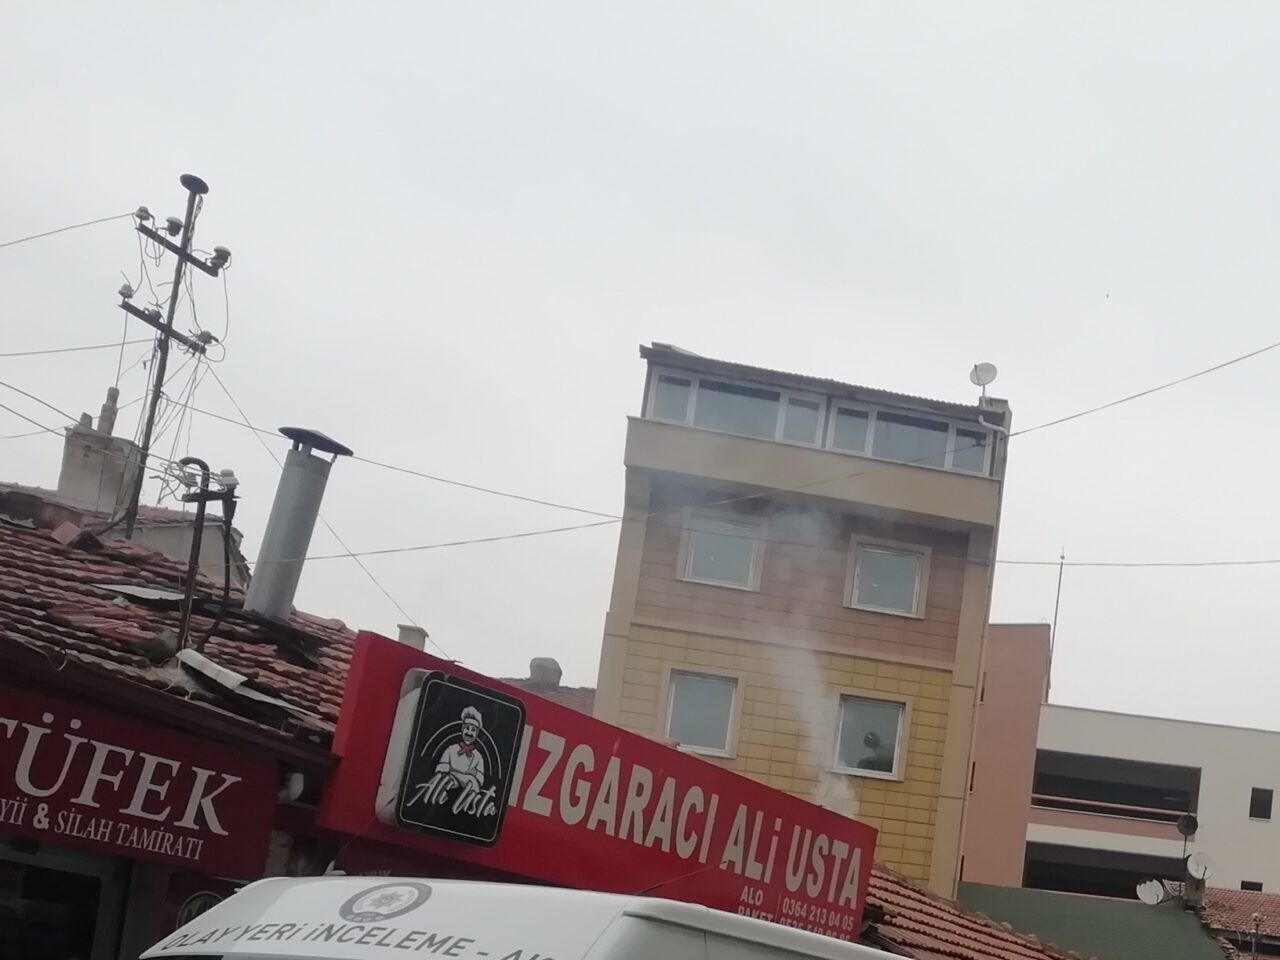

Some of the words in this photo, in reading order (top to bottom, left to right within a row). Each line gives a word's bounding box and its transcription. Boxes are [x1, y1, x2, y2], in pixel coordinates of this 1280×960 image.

[406, 772, 454, 807] Ali
[452, 781, 498, 818] Usta
[508, 724, 719, 864] IZGARACI
[785, 825, 863, 910] USTA
[33, 802, 50, 829] &
[54, 808, 115, 842] SİLAH
[115, 822, 204, 860] TAMİRATI
[740, 886, 763, 906] ALO
[782, 897, 807, 919] 0364
[808, 905, 826, 924] 213
[828, 911, 841, 927] 04
[841, 915, 855, 931] 05
[161, 926, 241, 951] OLAY
